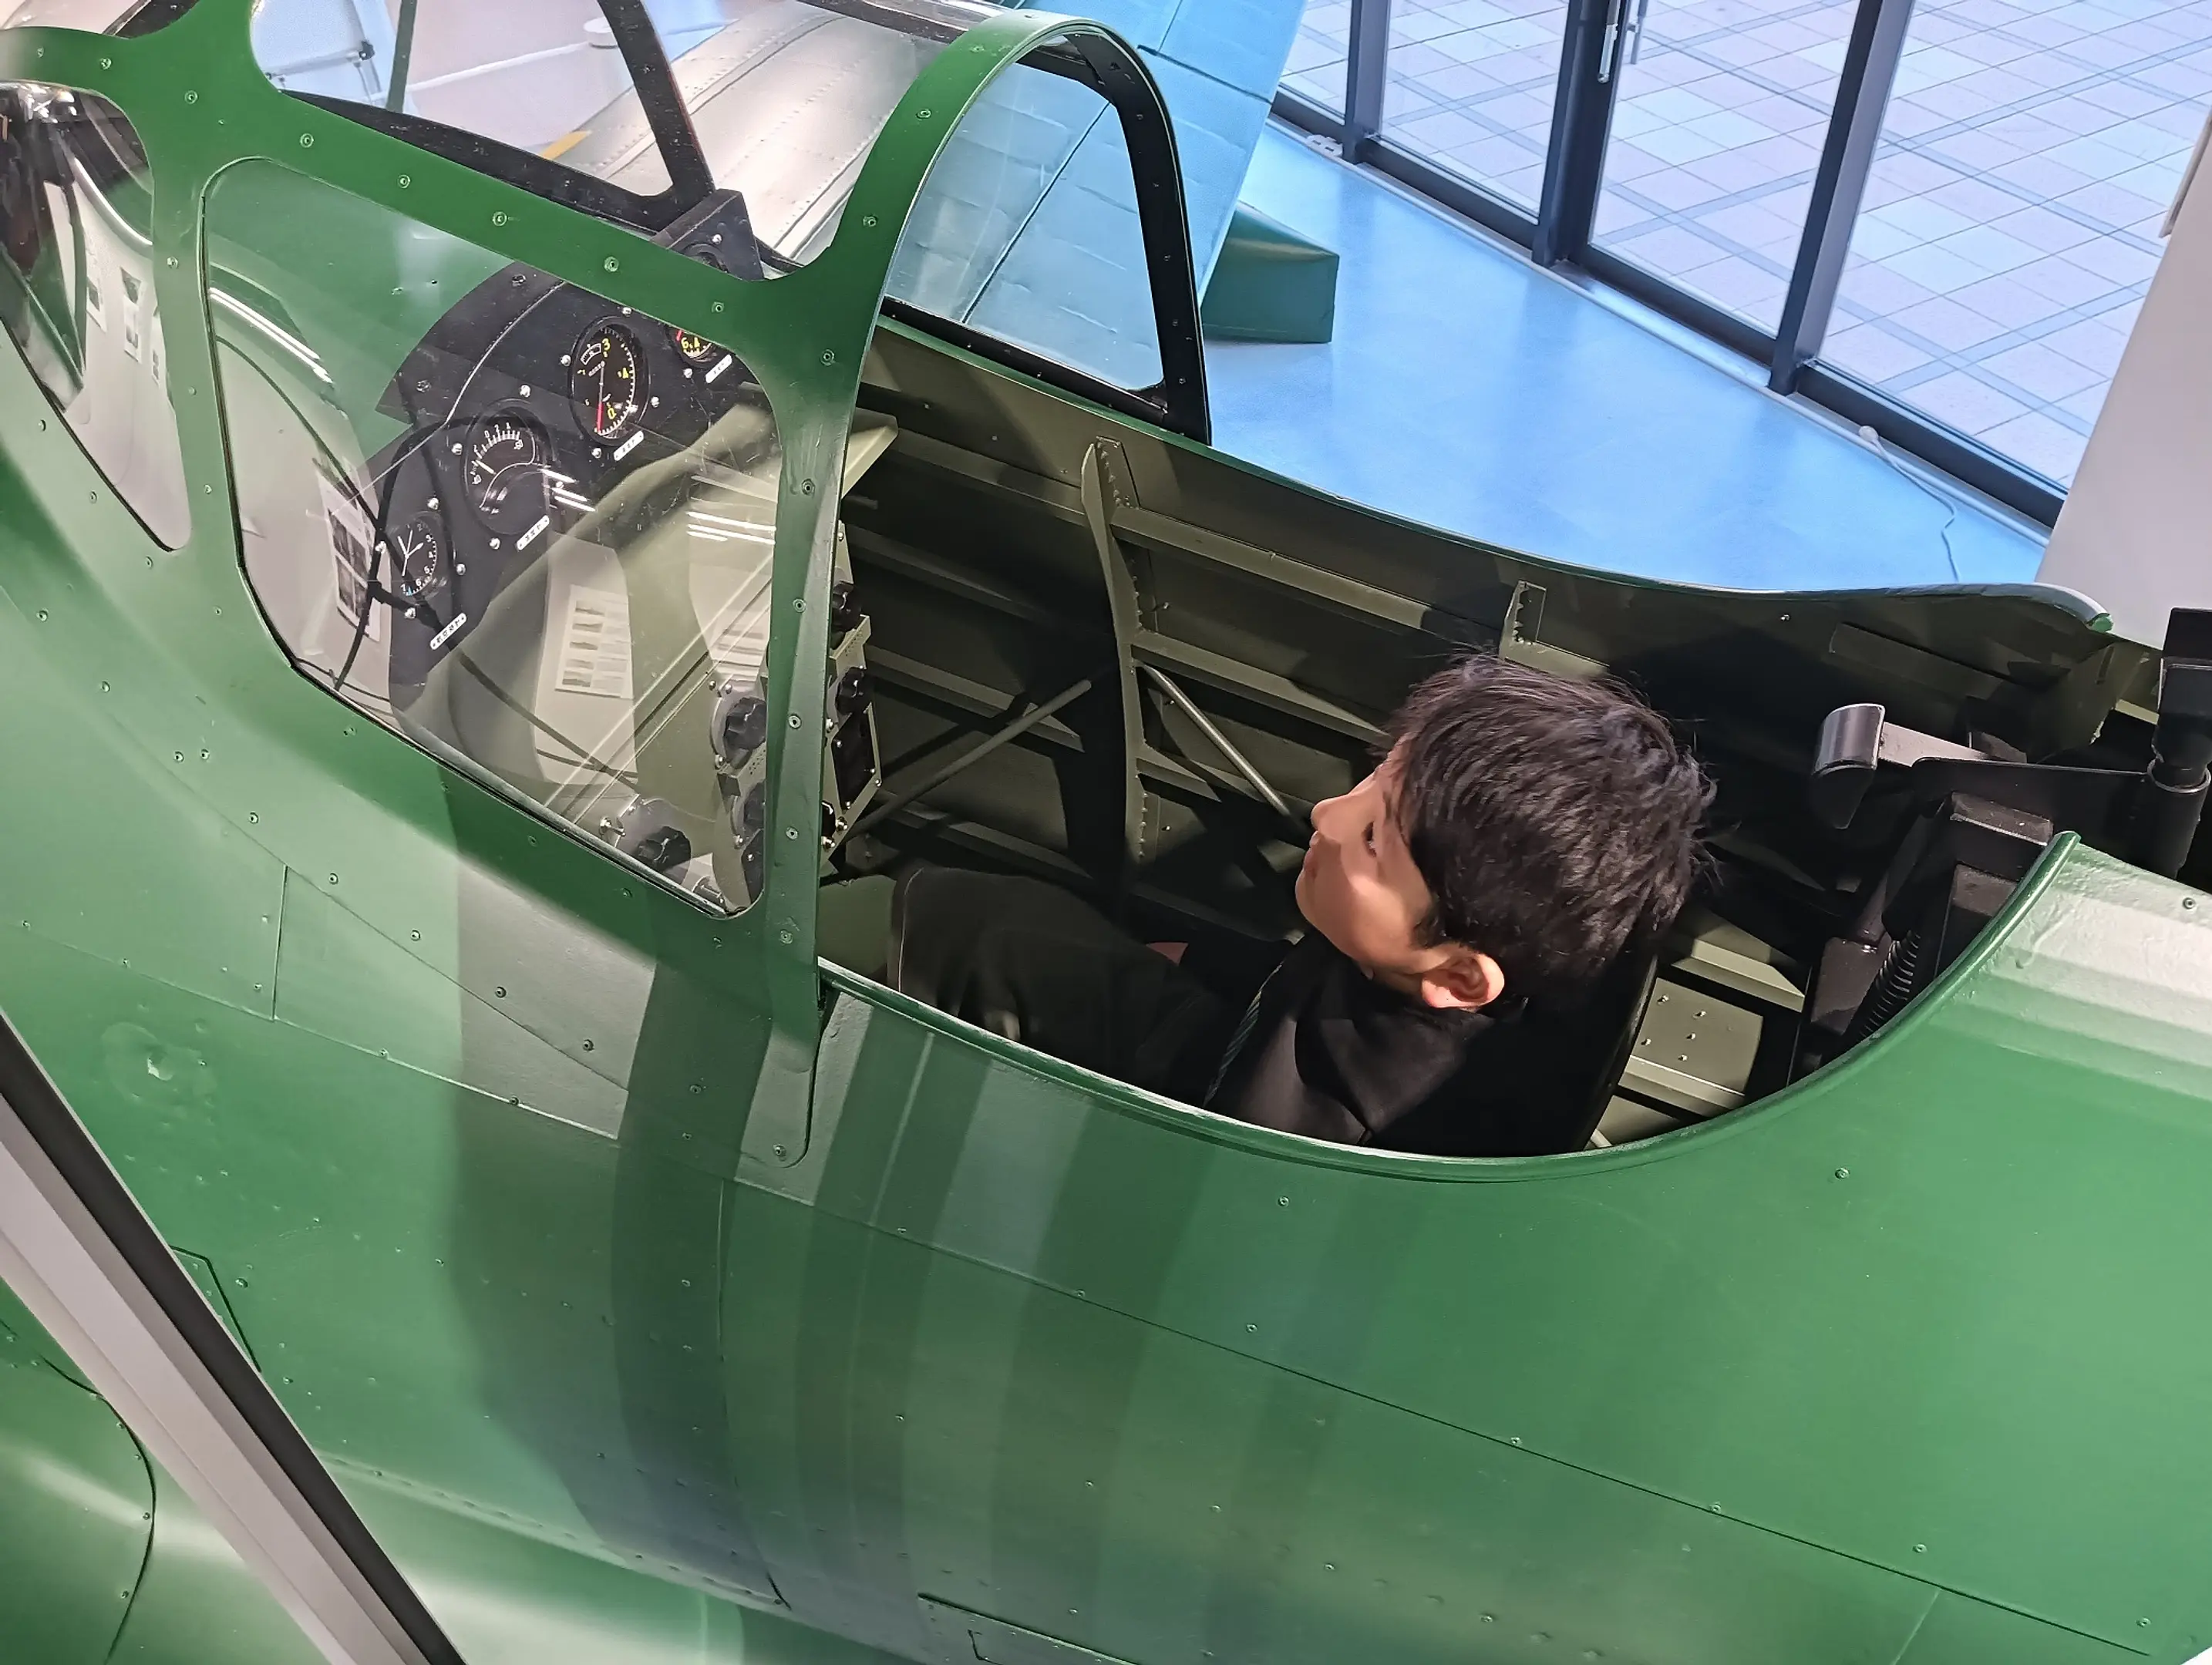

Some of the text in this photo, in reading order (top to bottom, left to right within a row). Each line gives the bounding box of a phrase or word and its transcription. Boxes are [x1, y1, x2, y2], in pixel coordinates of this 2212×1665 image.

[601, 338, 611, 351] 3
[681, 337, 689, 349] 6
[423, 565, 430, 574] 5
